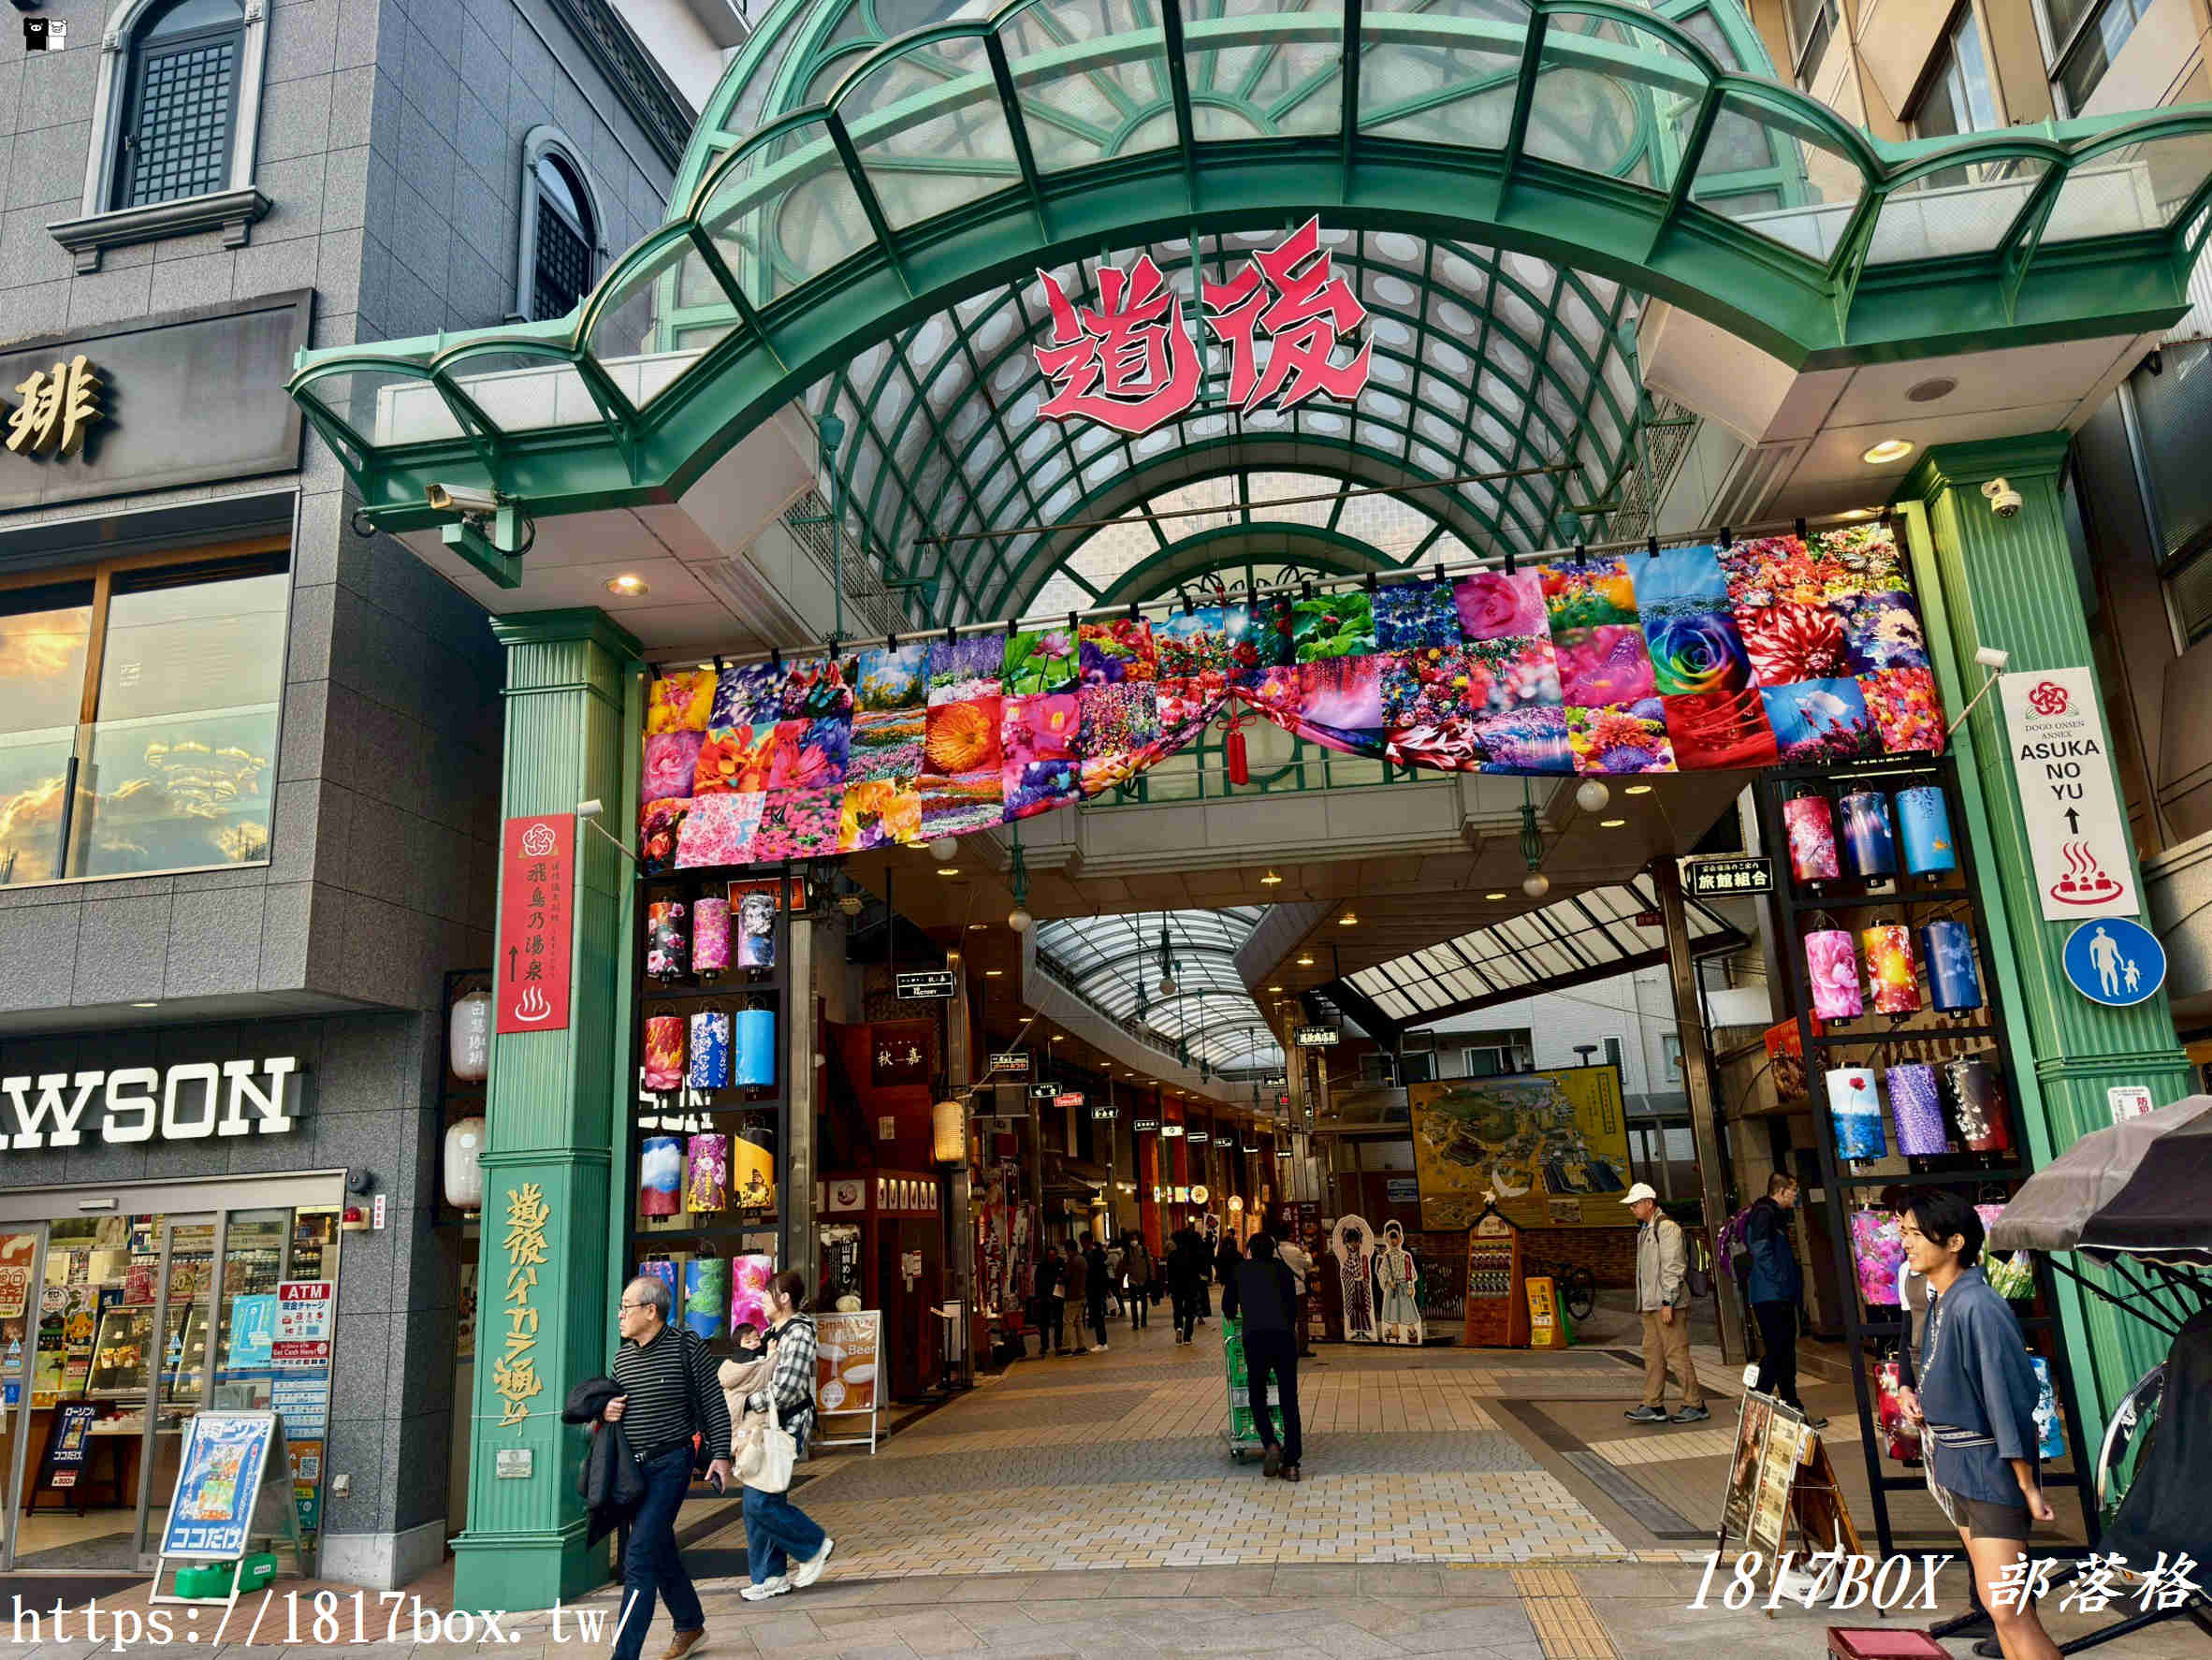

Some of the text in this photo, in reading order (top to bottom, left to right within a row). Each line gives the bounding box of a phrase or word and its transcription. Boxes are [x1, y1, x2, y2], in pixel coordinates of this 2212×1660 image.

[1033, 213, 1375, 434] 道後
[2025, 720, 2086, 732] DOGO ONSEN
[2042, 731, 2073, 739] ANNEX
[2020, 739, 2100, 761] ASUKA
[2045, 762, 2081, 779] NO
[2050, 782, 2083, 800] YU
[1698, 870, 1768, 889] 旅館組合
[524, 862, 548, 982] 飛鳥乃湯泉
[0, 1056, 296, 1150] WSON
[287, 1285, 323, 1300] ATM
